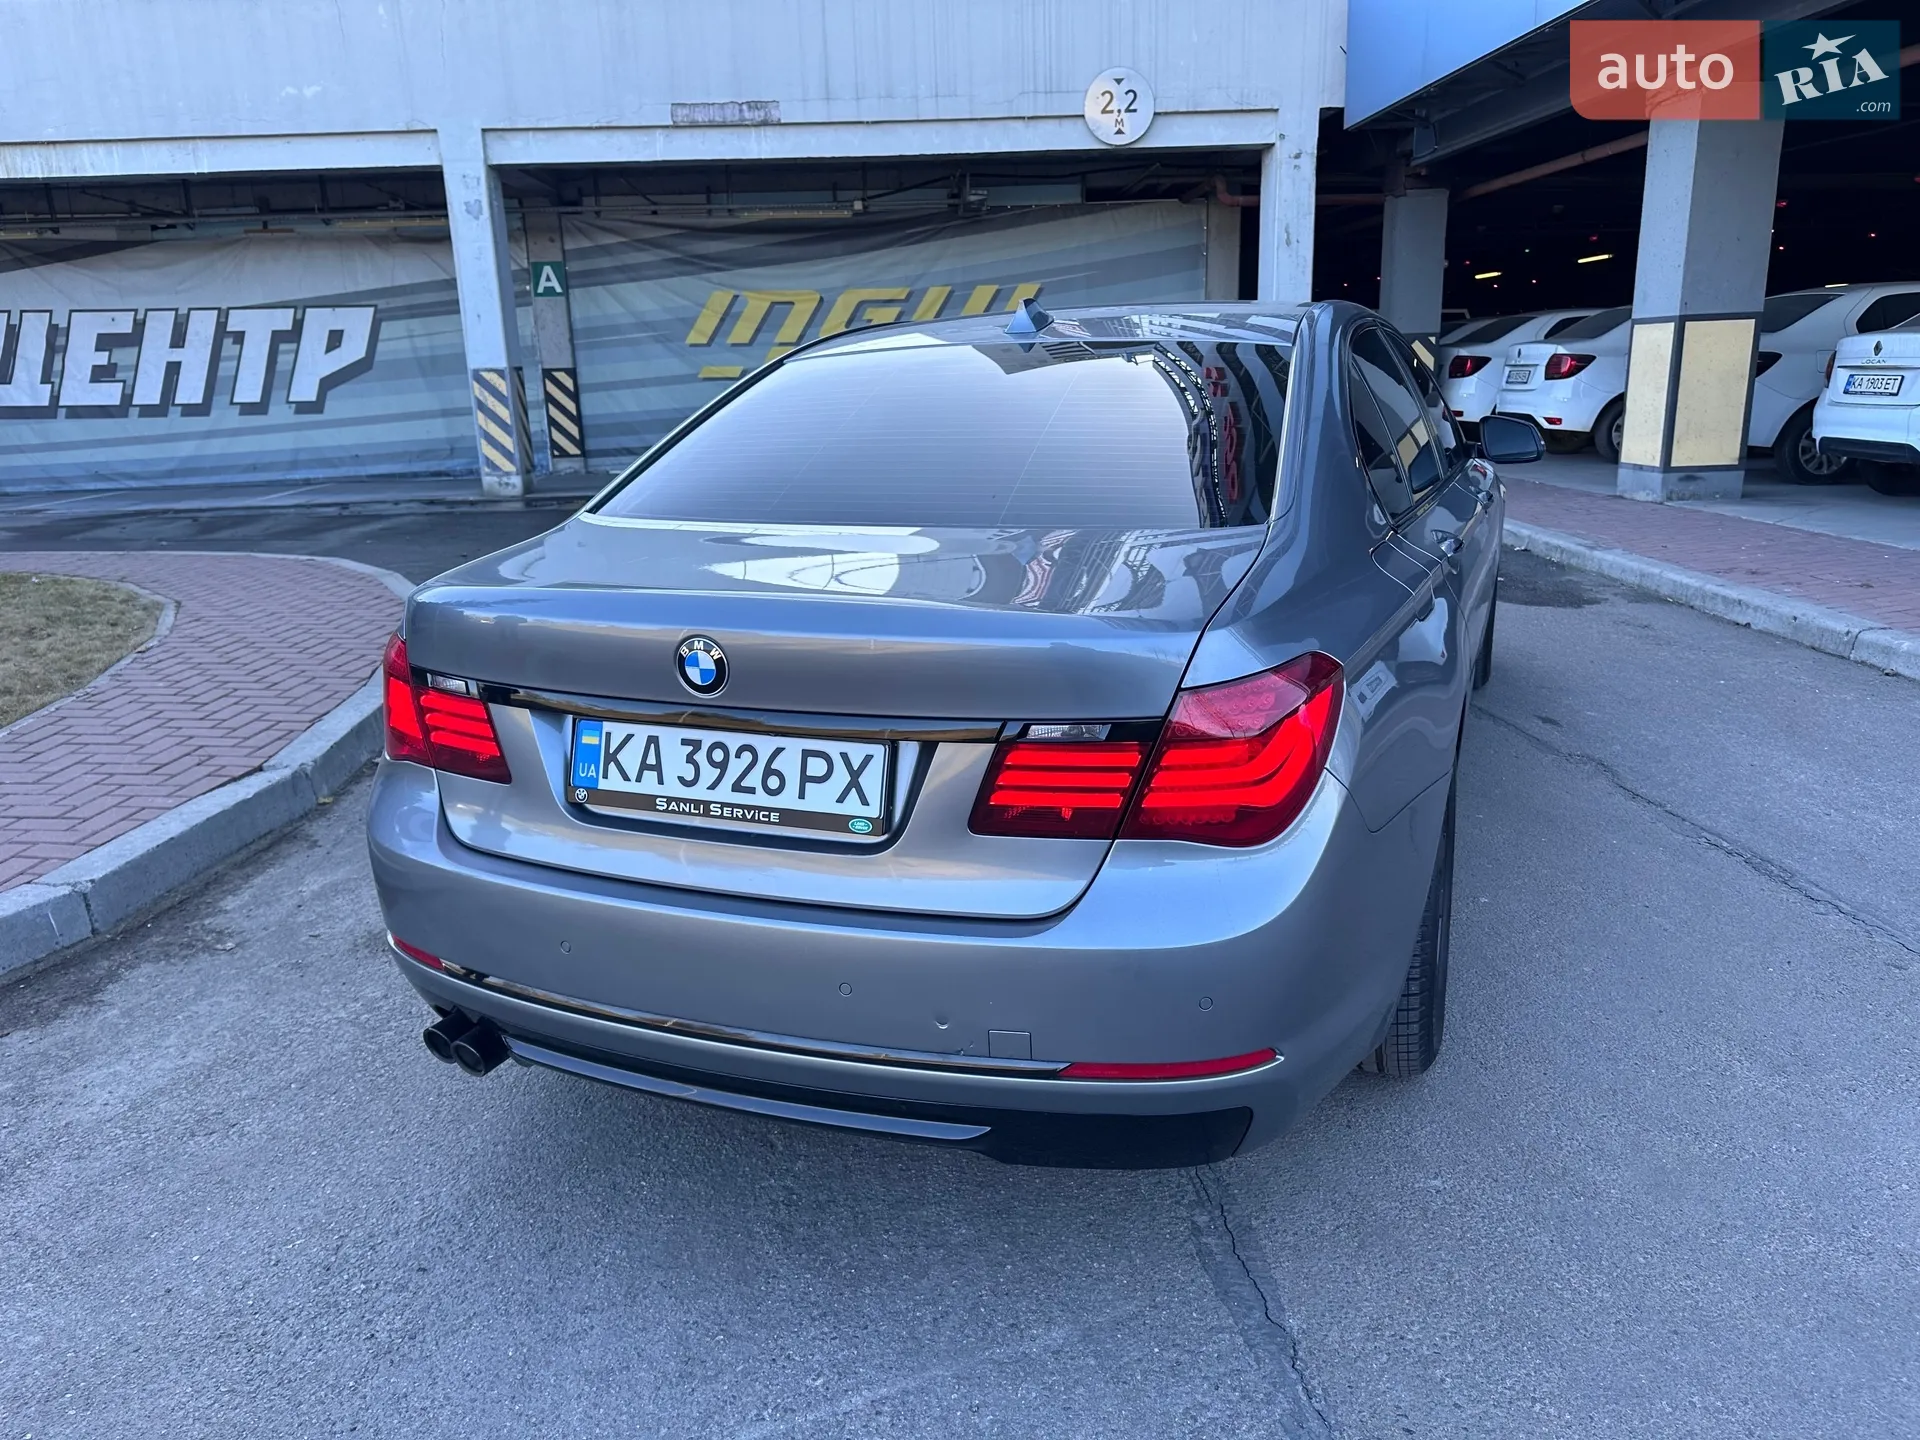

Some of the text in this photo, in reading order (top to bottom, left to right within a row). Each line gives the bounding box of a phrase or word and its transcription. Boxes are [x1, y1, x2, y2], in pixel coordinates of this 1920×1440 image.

[1100, 88, 1138, 117] 2,2
[537, 265, 563, 293] A
[1851, 377, 1899, 390] KA 1903 ET
[680, 640, 722, 660] BMW
[578, 762, 597, 779] UA
[601, 731, 875, 807] KA 3926 PX
